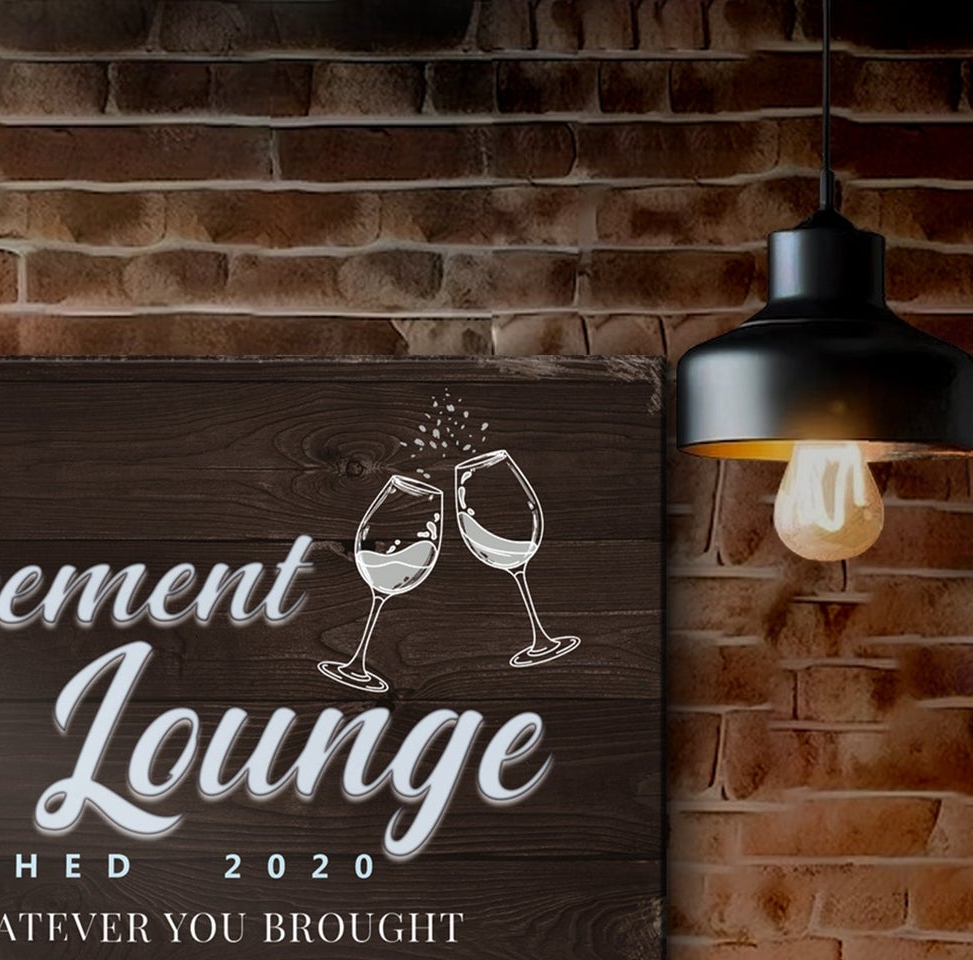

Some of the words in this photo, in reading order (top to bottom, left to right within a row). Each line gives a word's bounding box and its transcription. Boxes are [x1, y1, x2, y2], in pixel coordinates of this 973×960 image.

[35, 641, 551, 861] Lounge
[223, 852, 375, 879] 2020
[163, 911, 249, 944] YOU
[263, 911, 465, 944] BROUGHT
